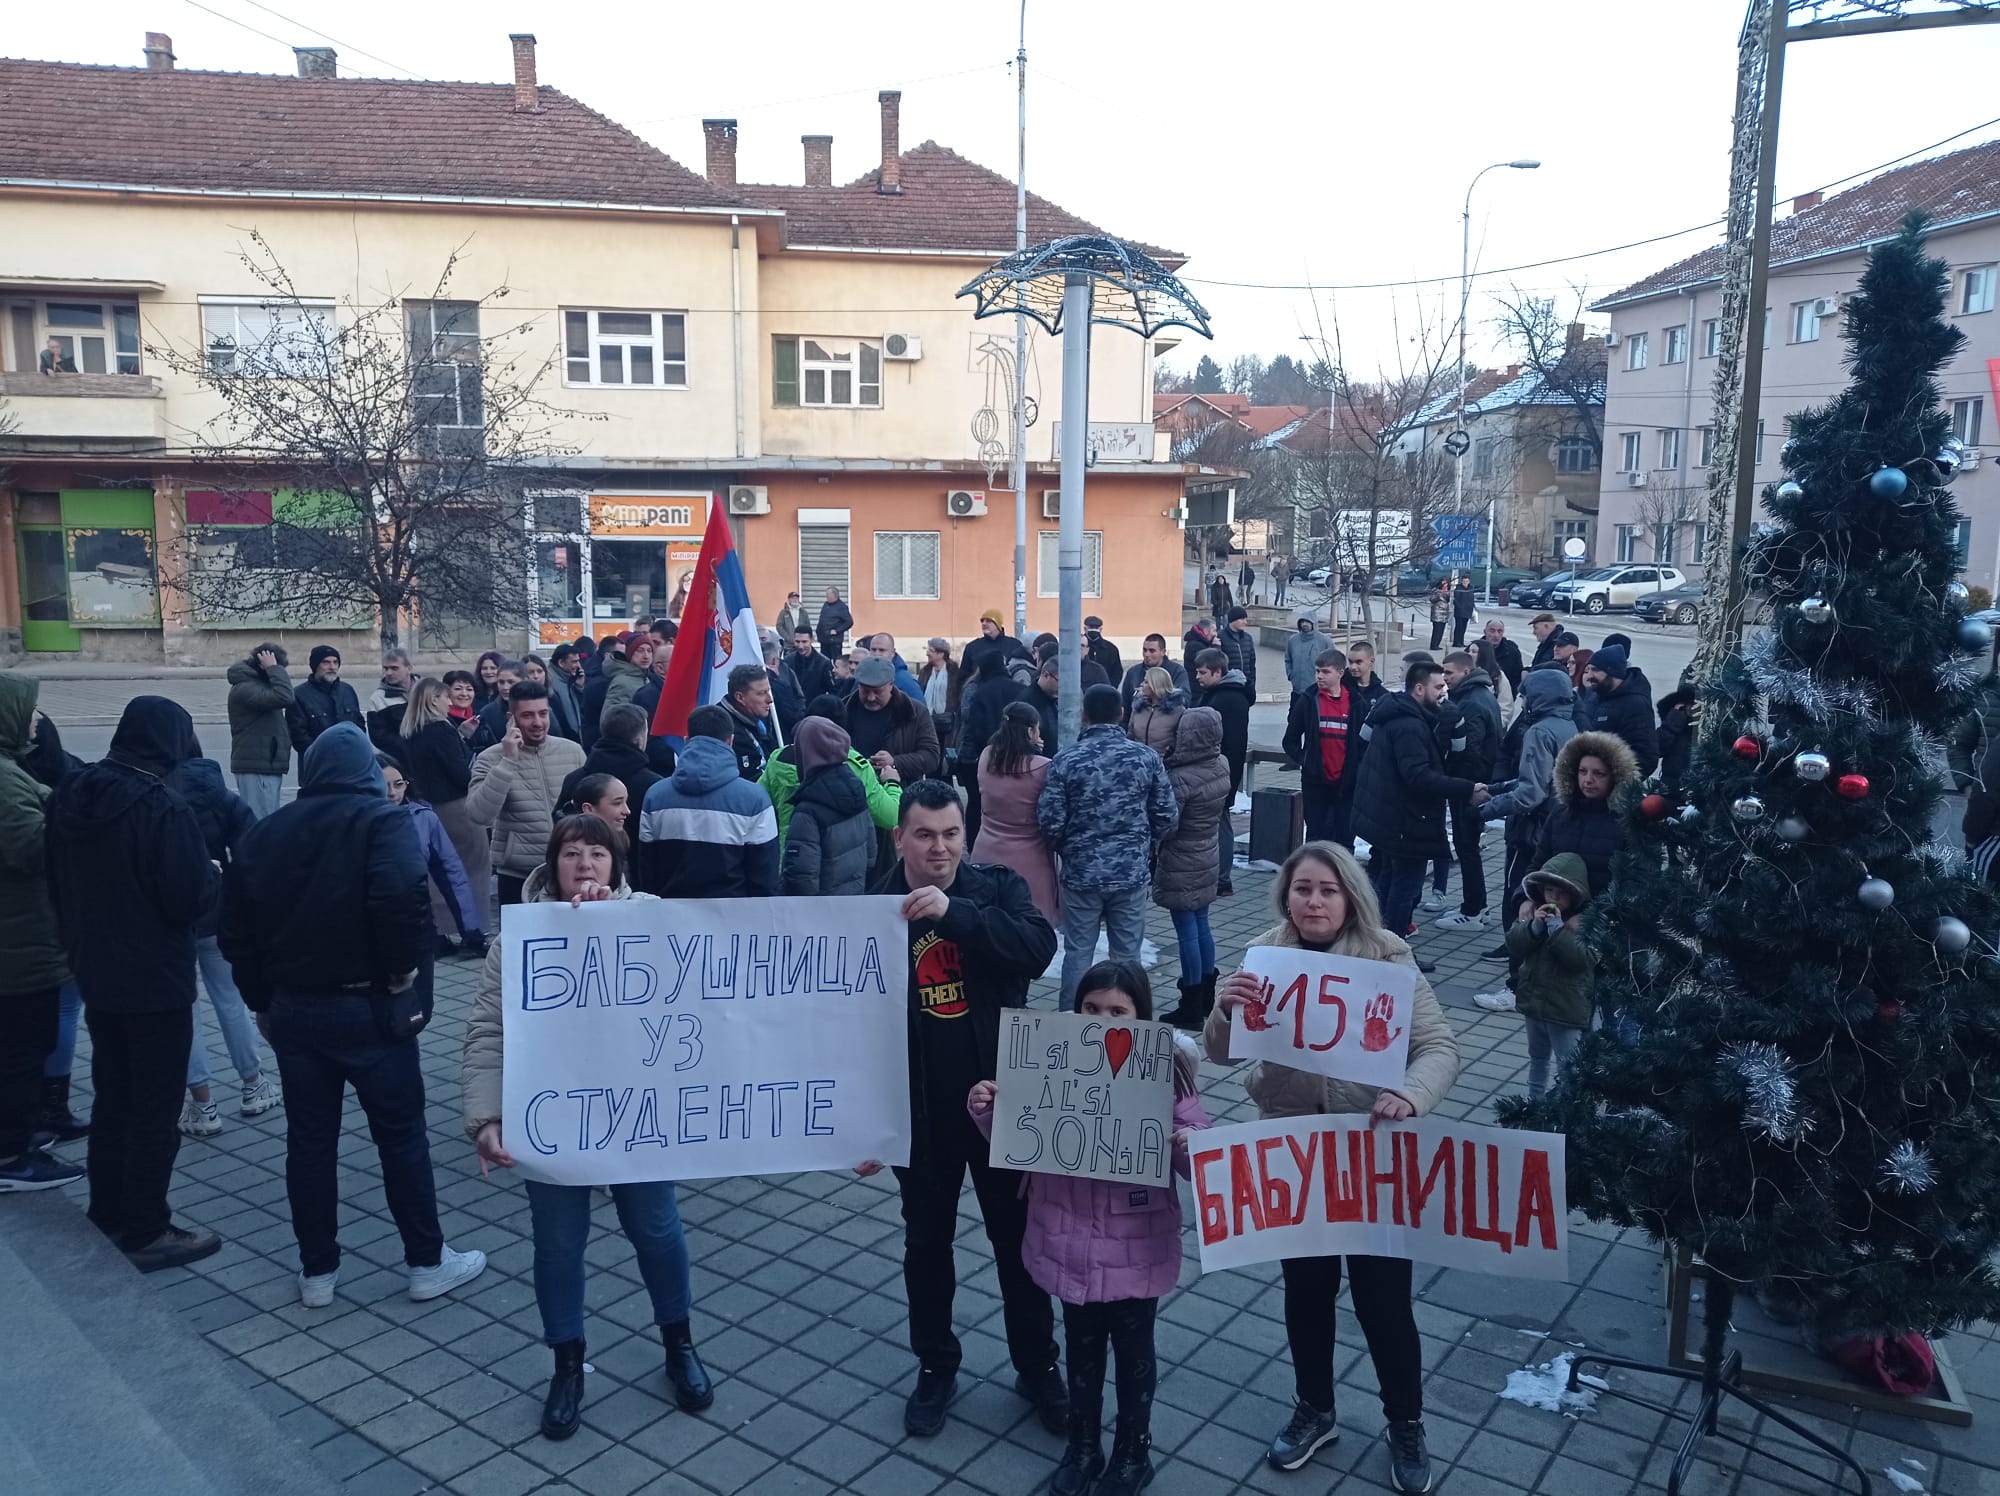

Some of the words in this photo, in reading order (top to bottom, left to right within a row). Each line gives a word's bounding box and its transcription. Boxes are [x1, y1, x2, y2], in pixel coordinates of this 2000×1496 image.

[603, 507, 689, 525] Minipani
[522, 934, 886, 1011] БАБУШНИЦА
[912, 937, 929, 961] UNK
[640, 1013, 704, 1072] УЗ
[1277, 973, 1350, 1051] 15
[525, 1080, 836, 1154] СТУДЕНТЕ
[1193, 1130, 1558, 1254] БАБУШНИЦА
